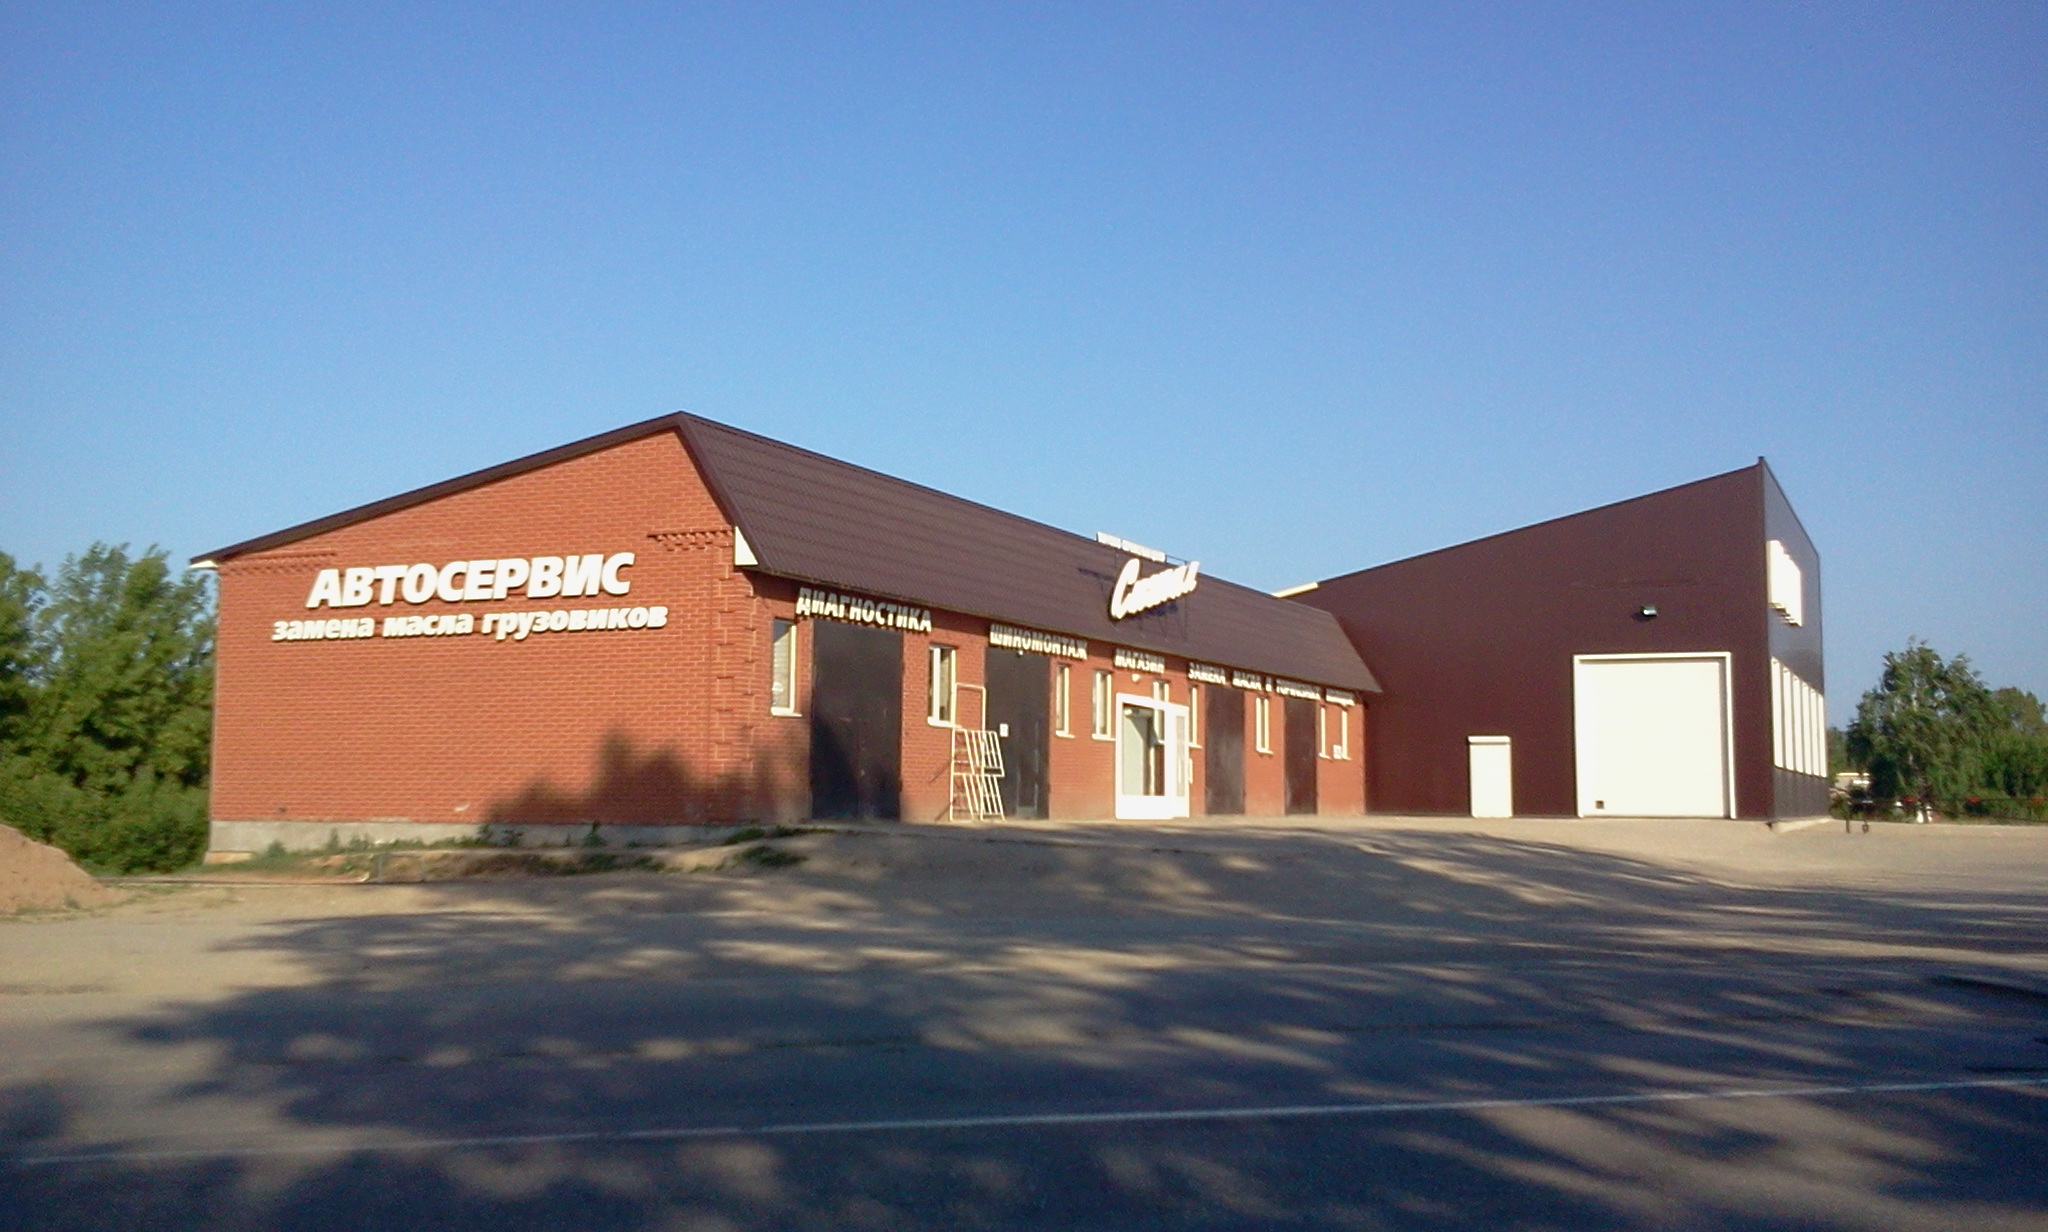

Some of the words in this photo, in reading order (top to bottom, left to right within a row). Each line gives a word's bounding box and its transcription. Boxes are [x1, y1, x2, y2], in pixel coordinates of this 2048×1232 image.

[306, 552, 635, 609] АВТОСЕРВИС
[271, 615, 375, 641] замена
[382, 611, 474, 638] масла
[481, 605, 669, 642] грузовиков
[795, 587, 932, 633] ДИАГНОСТИКА
[990, 624, 1088, 660] ШИНОМОНТАЖ
[1115, 648, 1165, 674] МАГАЗИН
